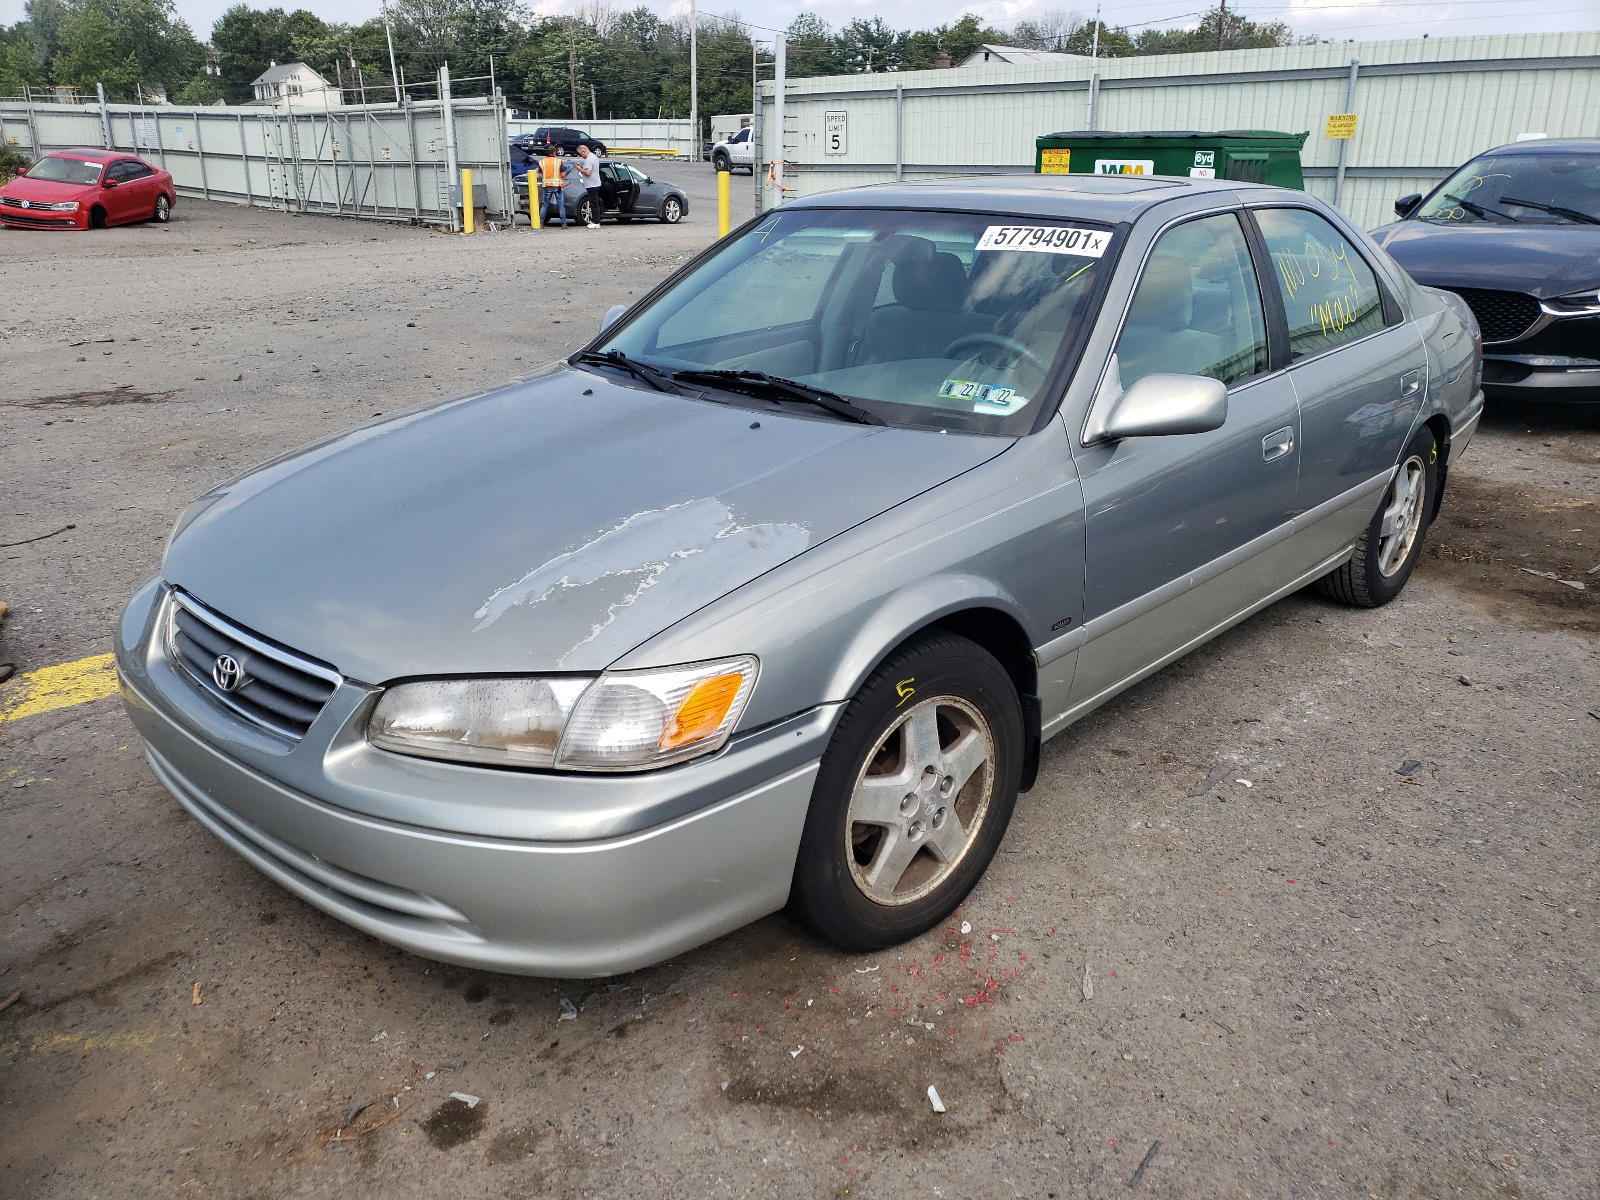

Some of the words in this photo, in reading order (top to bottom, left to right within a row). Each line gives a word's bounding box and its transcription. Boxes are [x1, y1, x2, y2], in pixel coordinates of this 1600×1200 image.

[831, 134, 840, 150] 5
[1195, 152, 1214, 165] 6yd
[960, 384, 974, 397] 22
[997, 389, 1011, 403] 22
